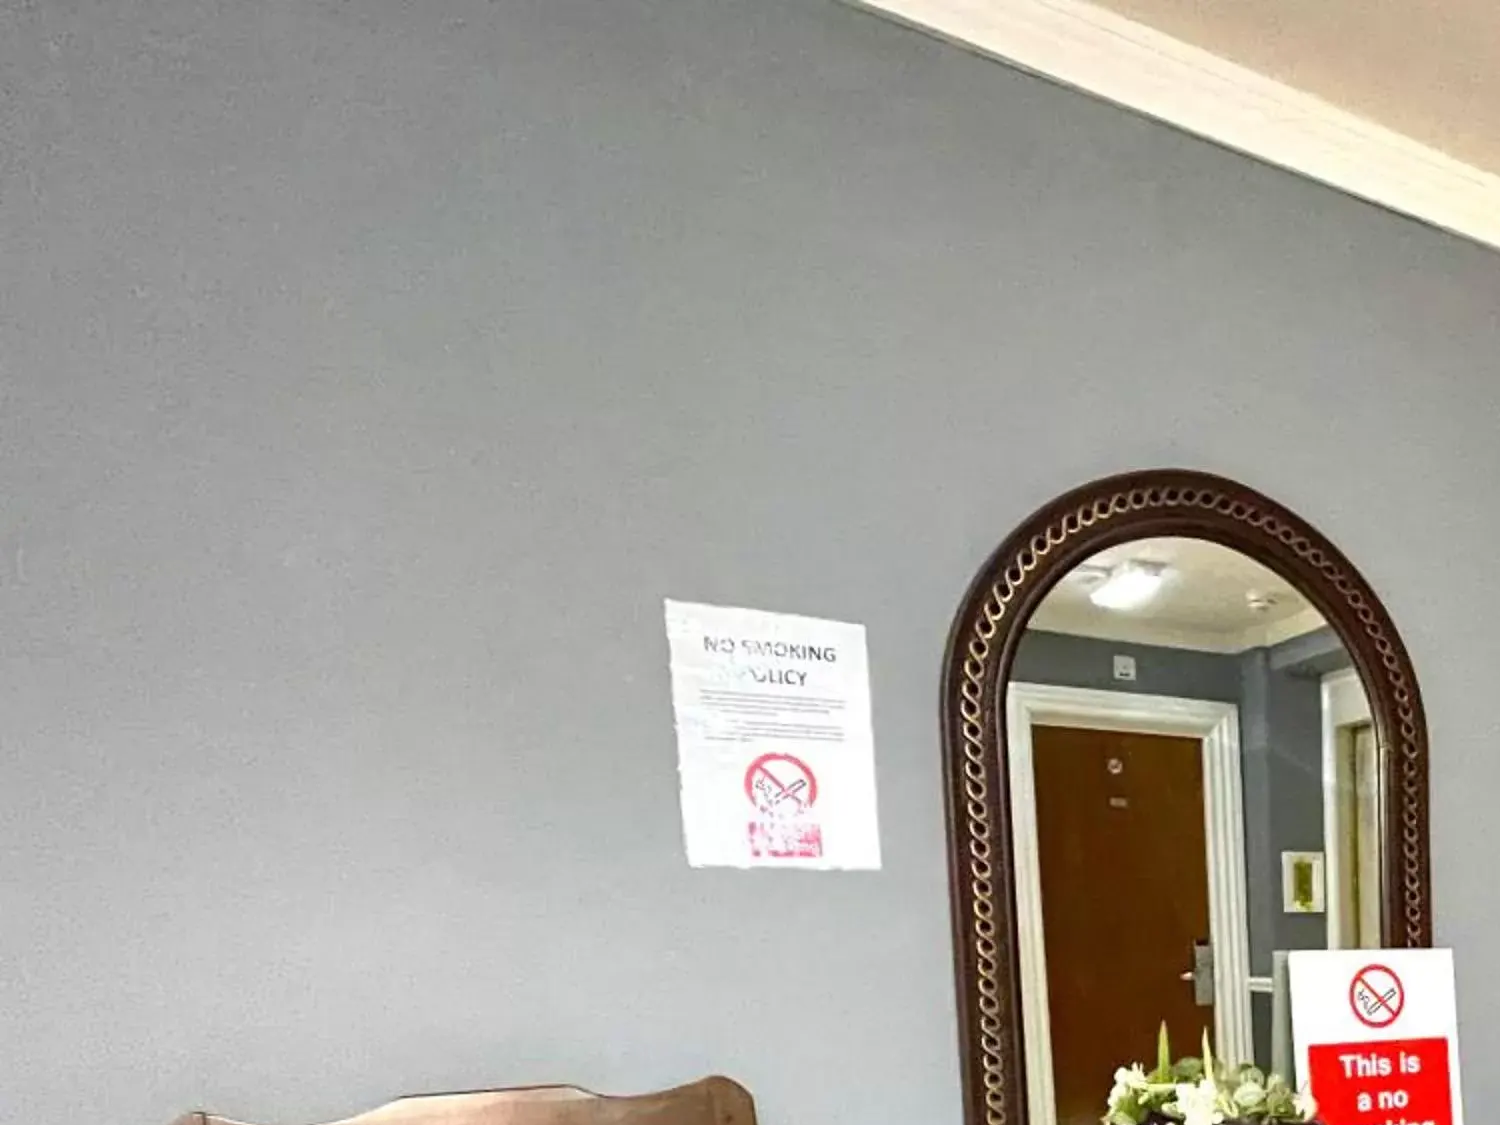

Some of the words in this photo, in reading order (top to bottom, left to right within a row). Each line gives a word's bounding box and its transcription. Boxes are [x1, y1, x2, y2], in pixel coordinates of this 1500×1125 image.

[703, 635, 736, 654] NO
[740, 666, 809, 687] OLICY
[1338, 1053, 1393, 1078] This
[1399, 1051, 1421, 1073] is
[1356, 1093, 1372, 1112] a
[1378, 1089, 1409, 1109] no
